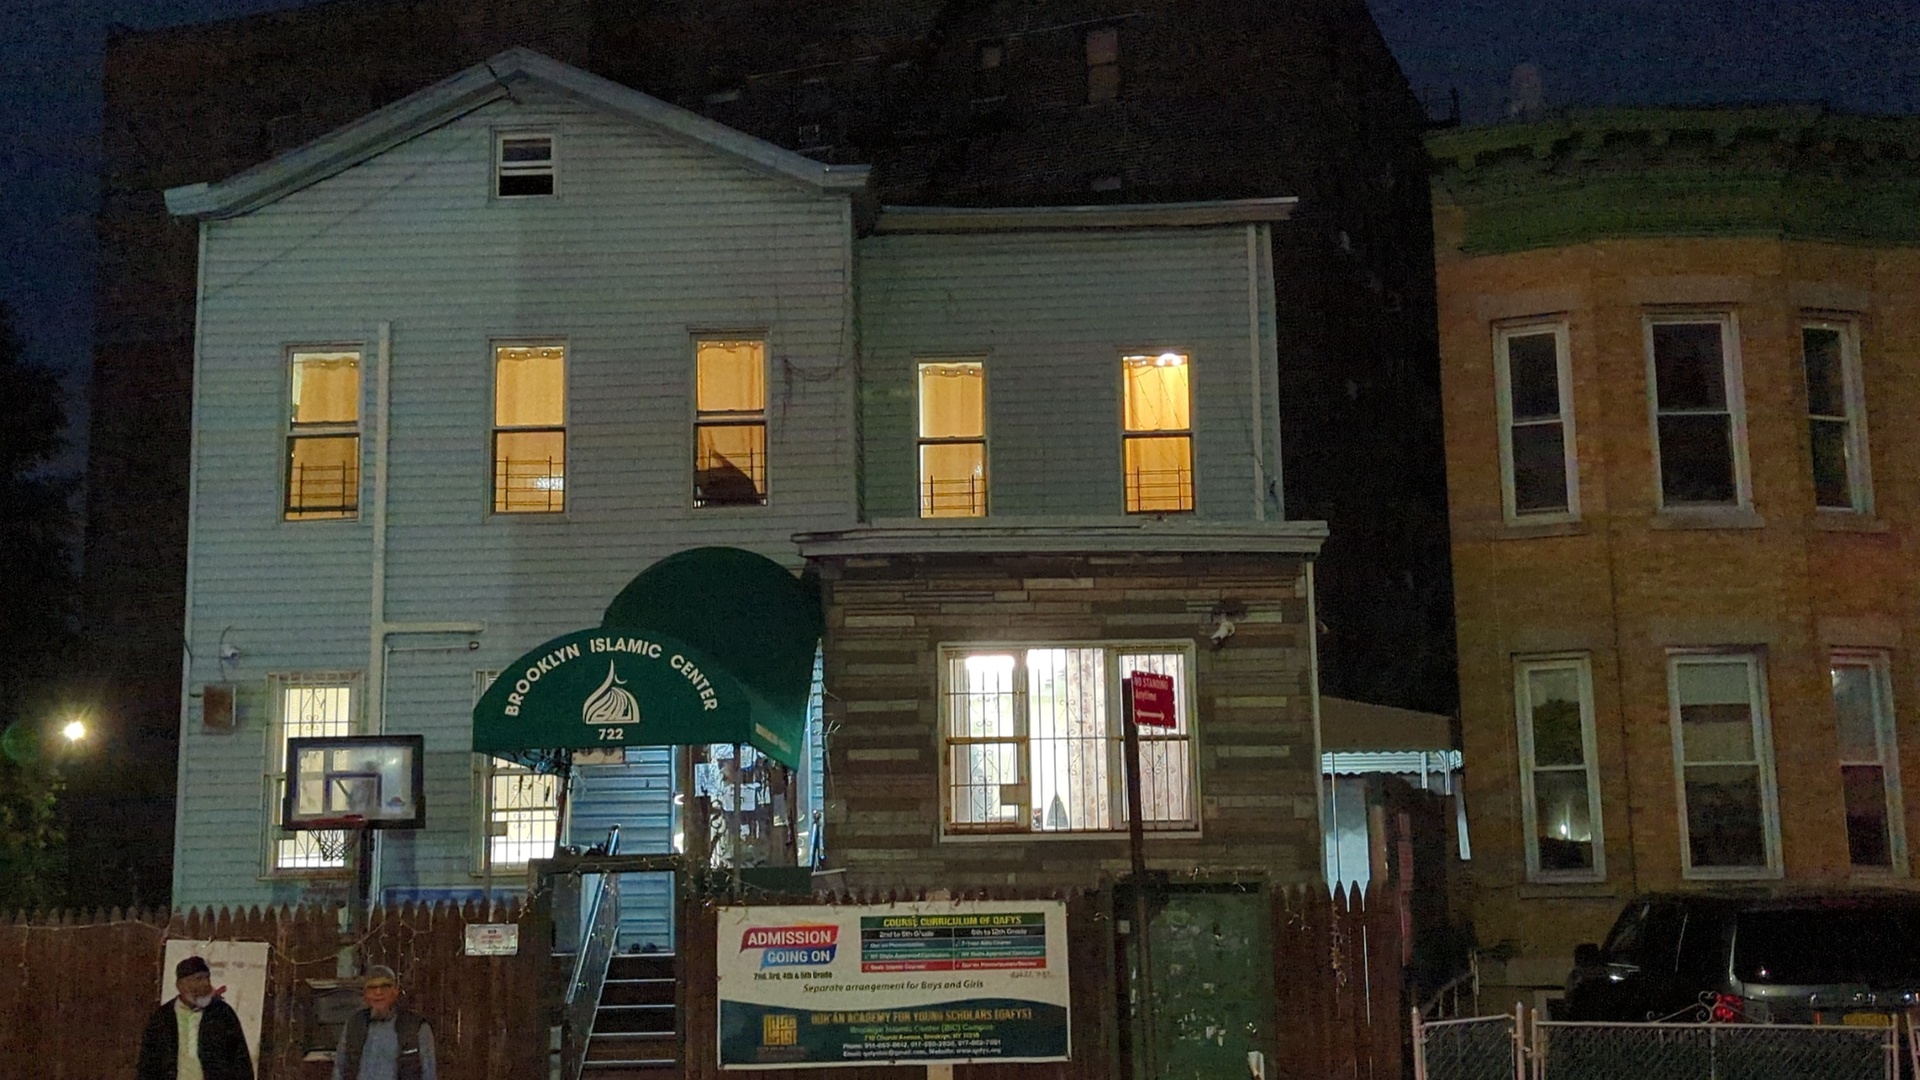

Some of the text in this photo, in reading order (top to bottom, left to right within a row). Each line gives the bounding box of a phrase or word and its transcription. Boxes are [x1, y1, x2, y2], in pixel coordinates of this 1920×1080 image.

[504, 637, 718, 718] BROOKLYN ISLAMIC CENTER
[1143, 677, 1169, 690] STANDING
[598, 728, 624, 740] 722
[883, 917, 918, 927] COURSE
[920, 916, 977, 926] CURRICULUM
[979, 916, 990, 925] OF
[747, 930, 831, 946] ADMISSION
[767, 950, 830, 963] GOING ON
[813, 971, 833, 979] Grade
[803, 980, 983, 993] Separate arrangement for Boys and Girls
[847, 1011, 890, 1023] ACADEMY
[893, 1011, 910, 1022] FOR
[914, 1010, 943, 1021] YOUNG
[946, 1009, 992, 1020] SCHOLARS
